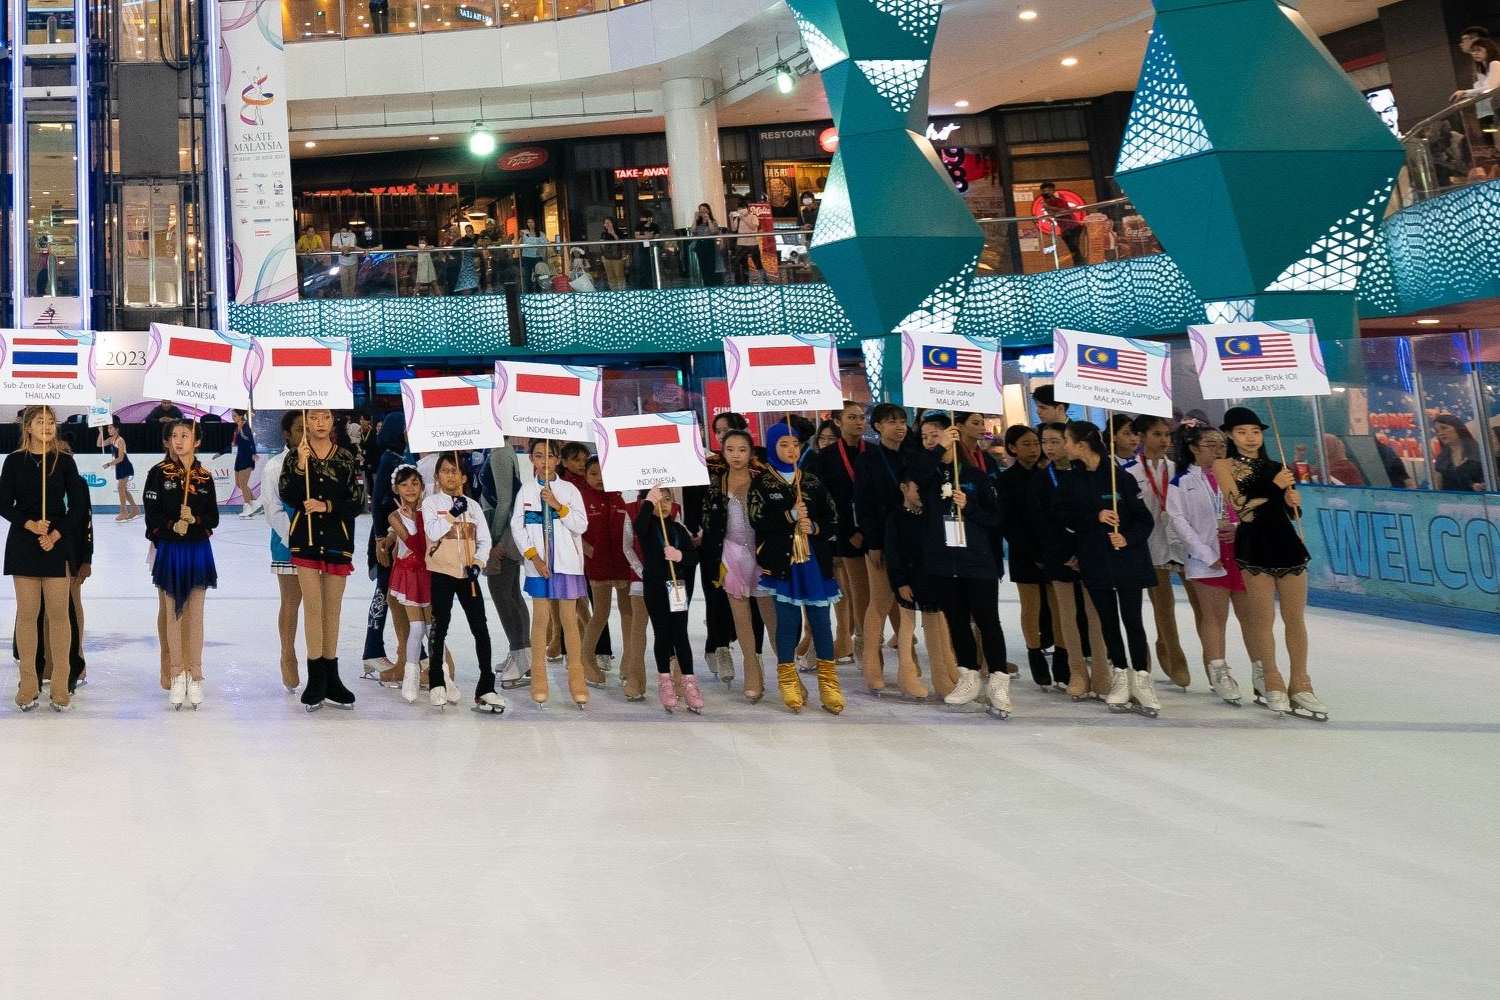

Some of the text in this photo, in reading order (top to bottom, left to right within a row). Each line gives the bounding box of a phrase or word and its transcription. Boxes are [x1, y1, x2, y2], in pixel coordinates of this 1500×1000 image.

[242, 132, 274, 142] SKATE
[760, 128, 816, 140] RESTORAN
[233, 141, 283, 152] MALAYSIA
[613, 167, 669, 179] TAKE-AWAY
[106, 351, 147, 367] 2023
[176, 378, 219, 391] SKA Ice Rink
[1227, 375, 1265, 385] Icescape
[1266, 373, 1284, 382] Rink
[3, 381, 84, 391] Sub-Zero Ice Skate Club
[1064, 381, 1161, 402] Blue Ice Rink Kuala Lumpur
[1242, 383, 1286, 393] MALAYSIA
[24, 391, 61, 400] THAILAND
[176, 389, 216, 401] INDONESIA
[278, 389, 329, 397] Tentrem On Ice
[751, 387, 821, 397] Oasis Centre Arena
[929, 386, 976, 398] Blue Ice Johor
[284, 399, 323, 407] INDONESIA
[765, 397, 808, 406] INDONESIA
[935, 397, 970, 408] MALAYSIA
[1093, 394, 1133, 407] MALAYSIA
[512, 414, 584, 429] Gardenice Bandung
[430, 428, 481, 440] SCH Yogyakarta
[526, 425, 567, 436] INDONESIA
[437, 438, 474, 448] INDONESIA
[640, 466, 668, 476] BX Rink
[636, 475, 677, 486] INDONESIA
